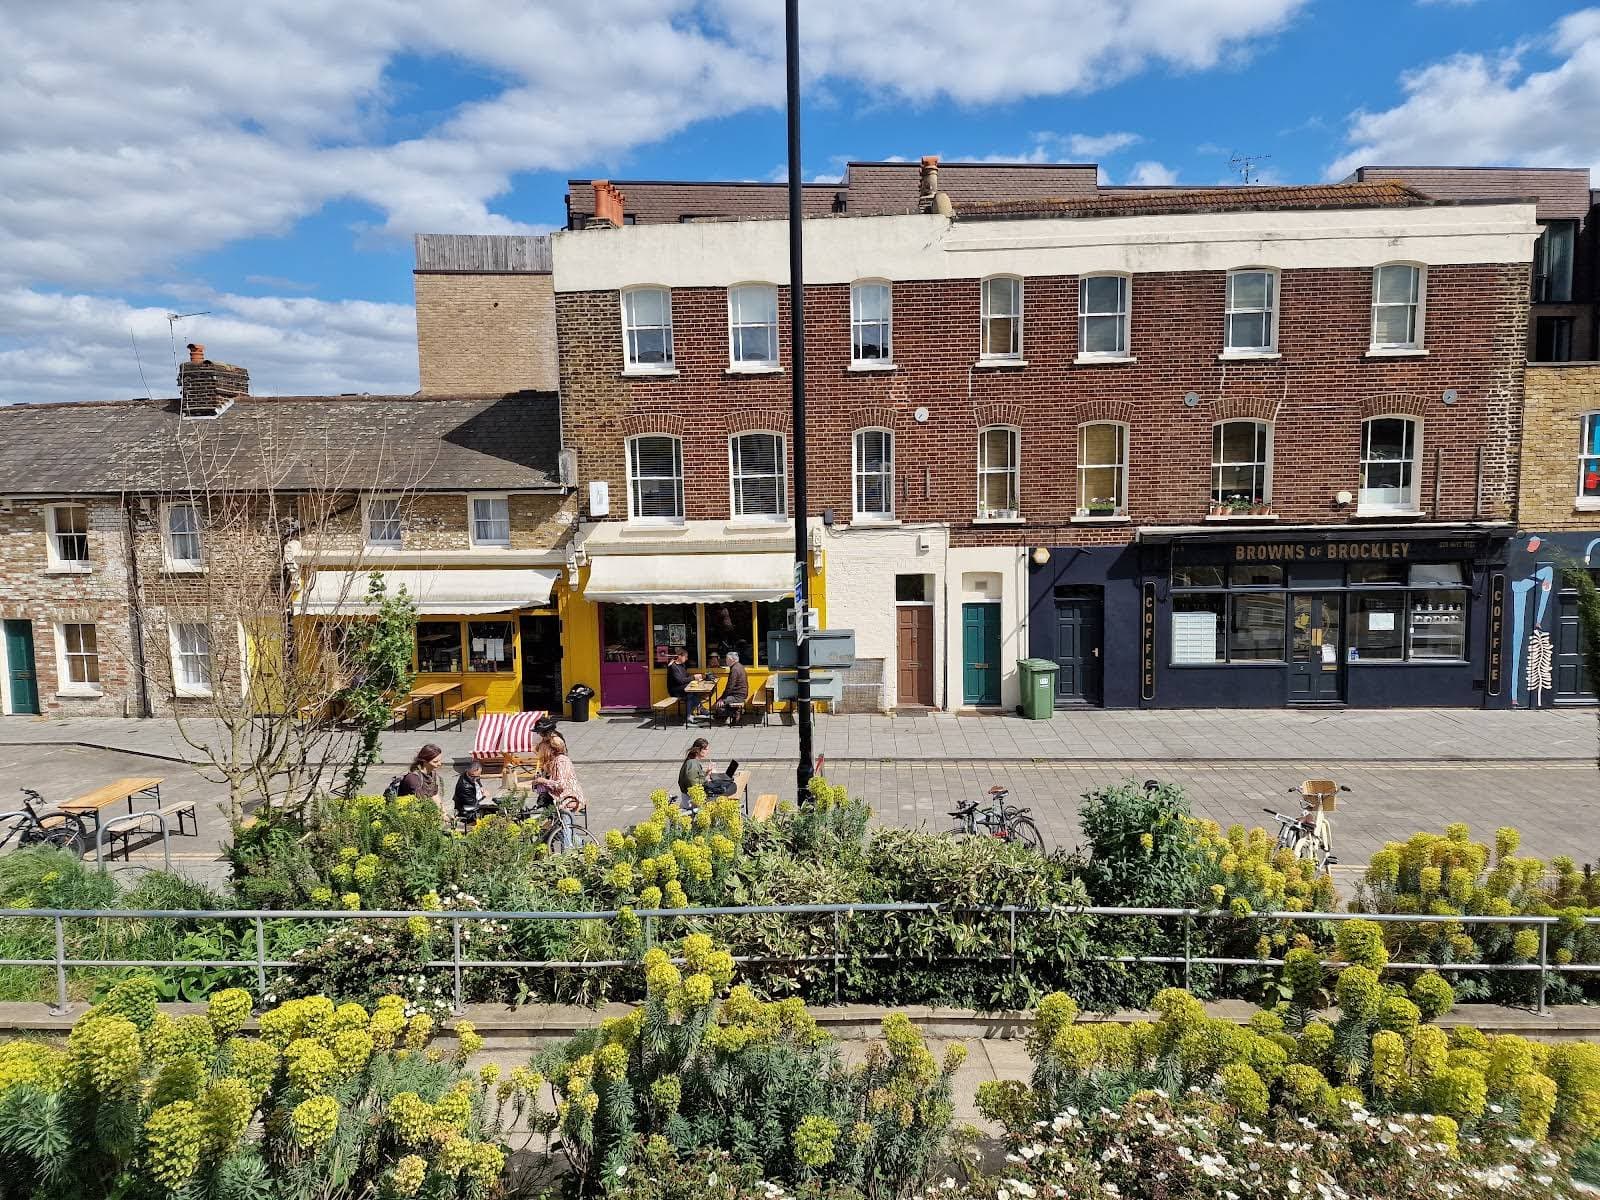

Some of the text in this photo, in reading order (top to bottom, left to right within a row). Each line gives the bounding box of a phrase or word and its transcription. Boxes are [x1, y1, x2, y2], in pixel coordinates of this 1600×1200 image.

[1235, 542, 1411, 560] BROWNS OF BROCKLEY
[1145, 597, 1154, 685] COFFEE
[1491, 590, 1502, 680] COFFEE
